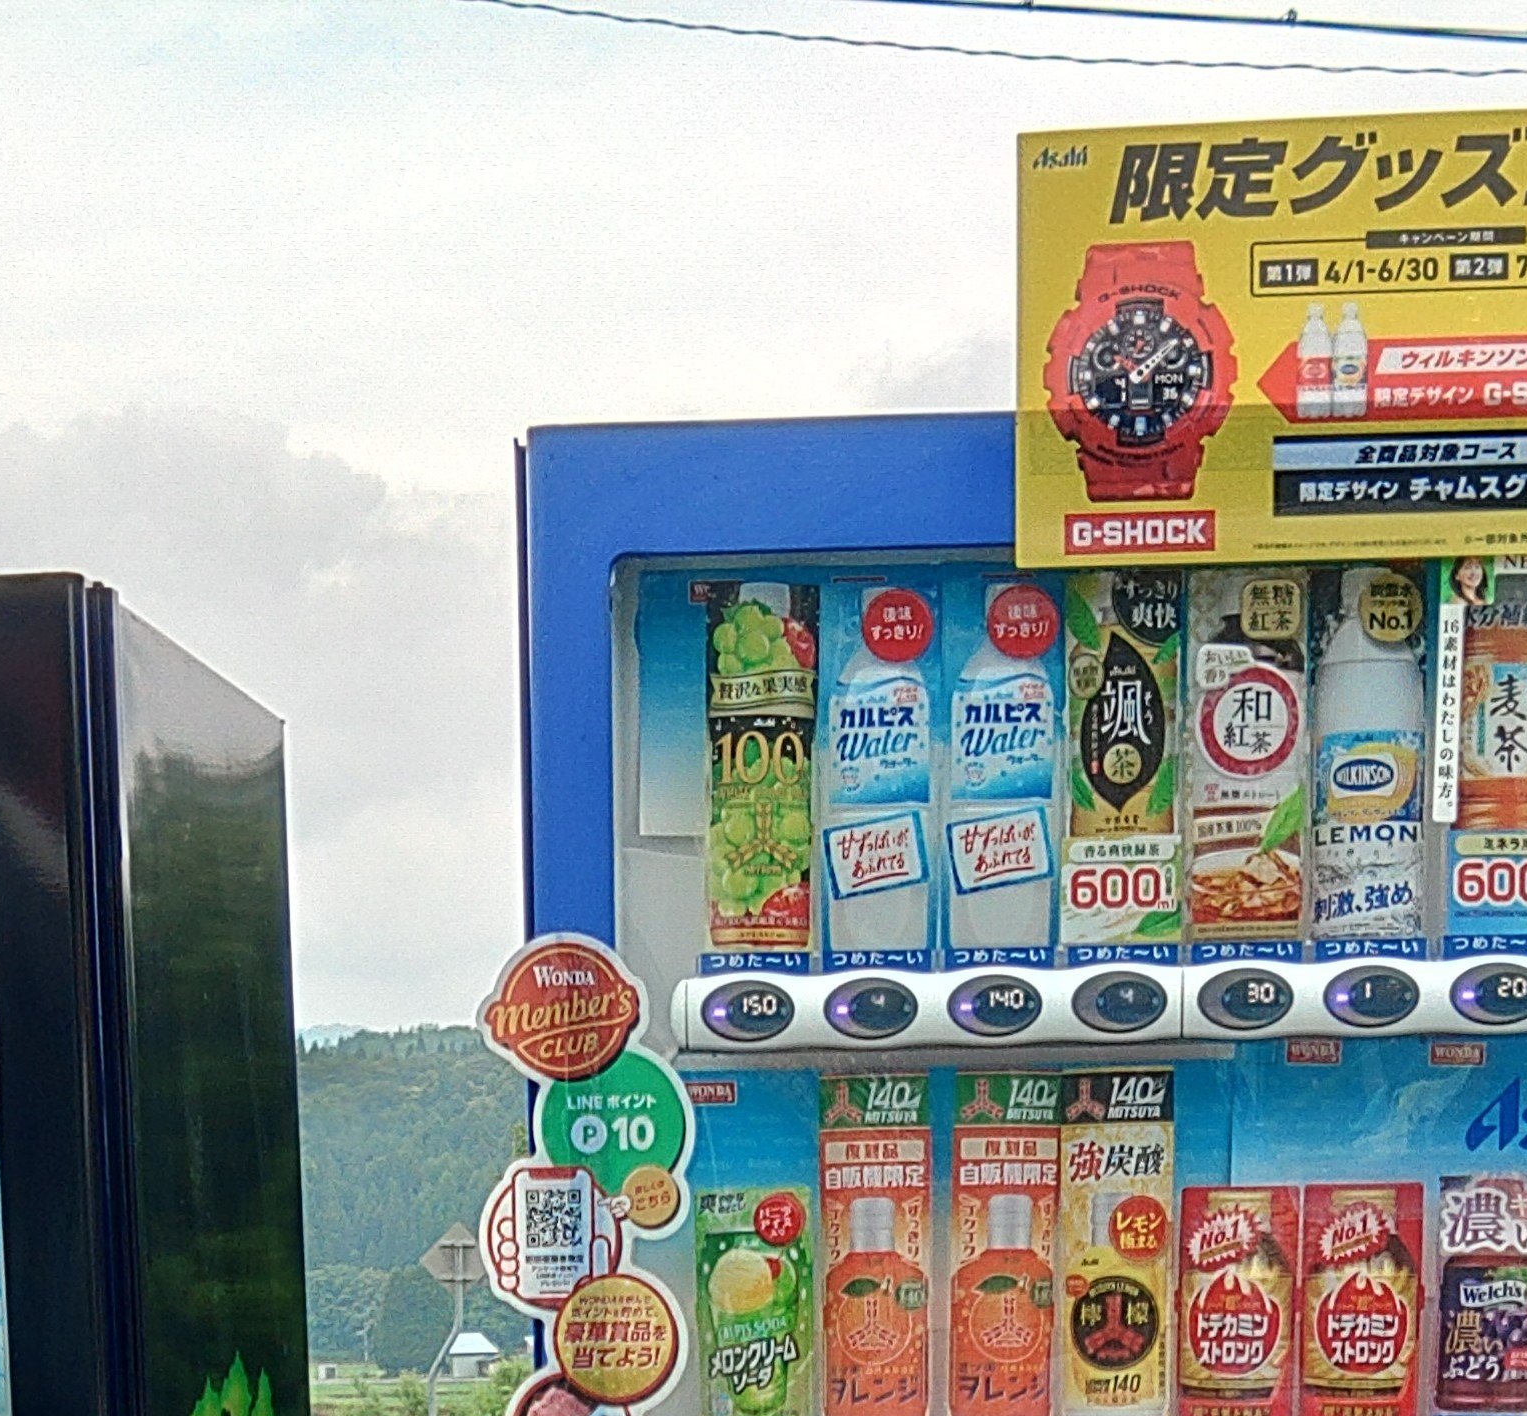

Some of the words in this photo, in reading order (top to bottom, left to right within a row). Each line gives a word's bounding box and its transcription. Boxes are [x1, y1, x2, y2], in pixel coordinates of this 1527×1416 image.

[1265, 263, 1312, 281] 第1弾
[1324, 257, 1438, 284] 4/1-6/30
[1454, 257, 1504, 276] 第2弾
[1072, 518, 1207, 546] G-SHOCK
[1369, 611, 1415, 631] No.1
[840, 707, 915, 729] カルピス
[836, 731, 918, 762] Water
[1314, 824, 1419, 846] LEMON
[533, 965, 595, 988] WONDA
[492, 982, 632, 1036] Member's
[540, 1031, 598, 1058] CLUB
[566, 1095, 603, 1110] LINE
[607, 1092, 656, 1109] ポイント
[611, 1115, 655, 1151] 10
[1461, 1283, 1526, 1306] Welch's
